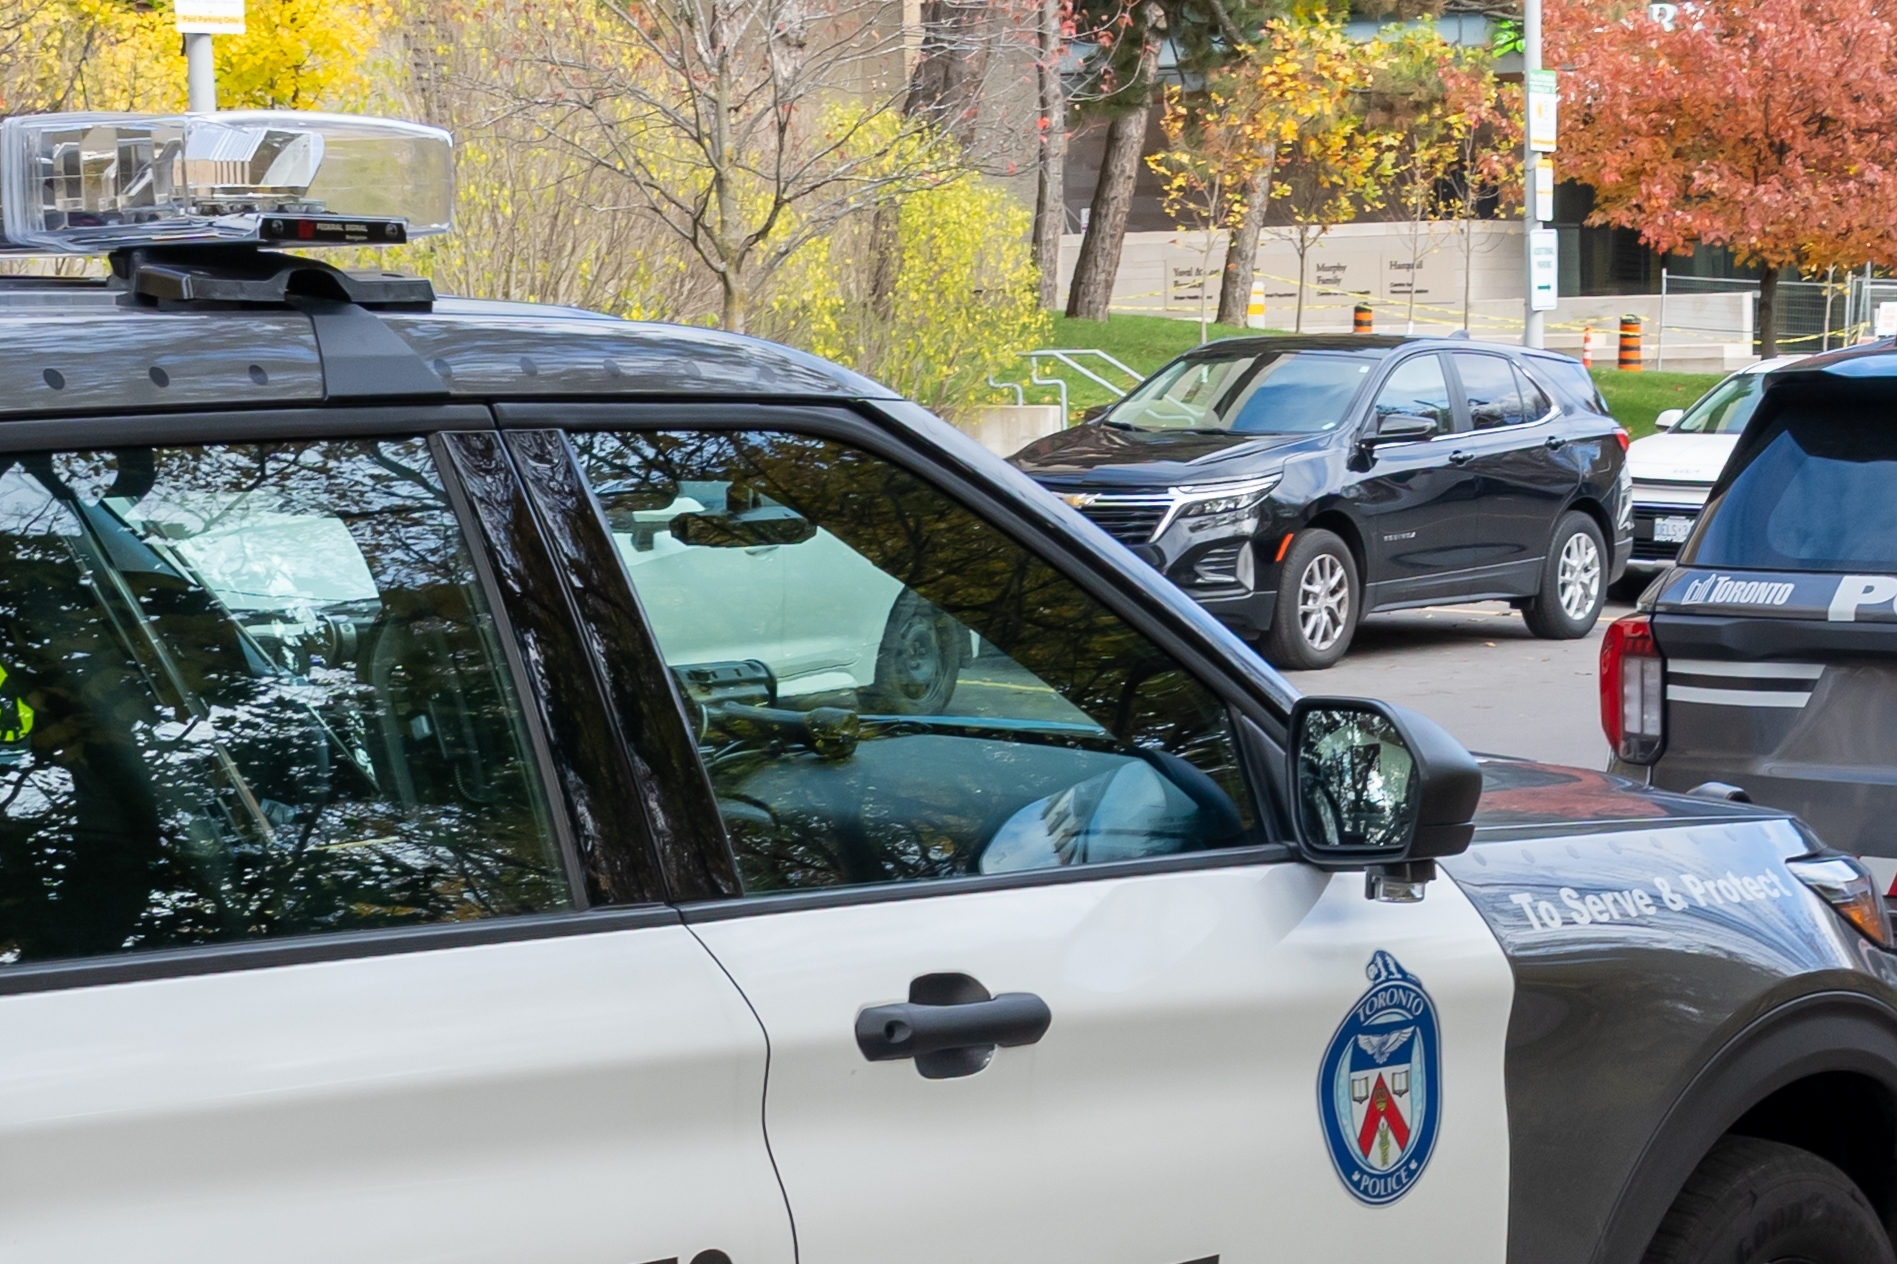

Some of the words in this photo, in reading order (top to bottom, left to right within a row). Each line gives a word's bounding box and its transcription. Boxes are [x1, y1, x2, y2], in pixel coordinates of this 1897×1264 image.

[1710, 575, 1795, 606] TORONTO
[1508, 891, 1564, 931] To
[1559, 886, 1658, 926] Serve
[1653, 875, 1690, 912] &
[1678, 866, 1794, 907] Protect
[1356, 987, 1425, 1023] TORONTO
[1359, 1165, 1410, 1197] POLICE
